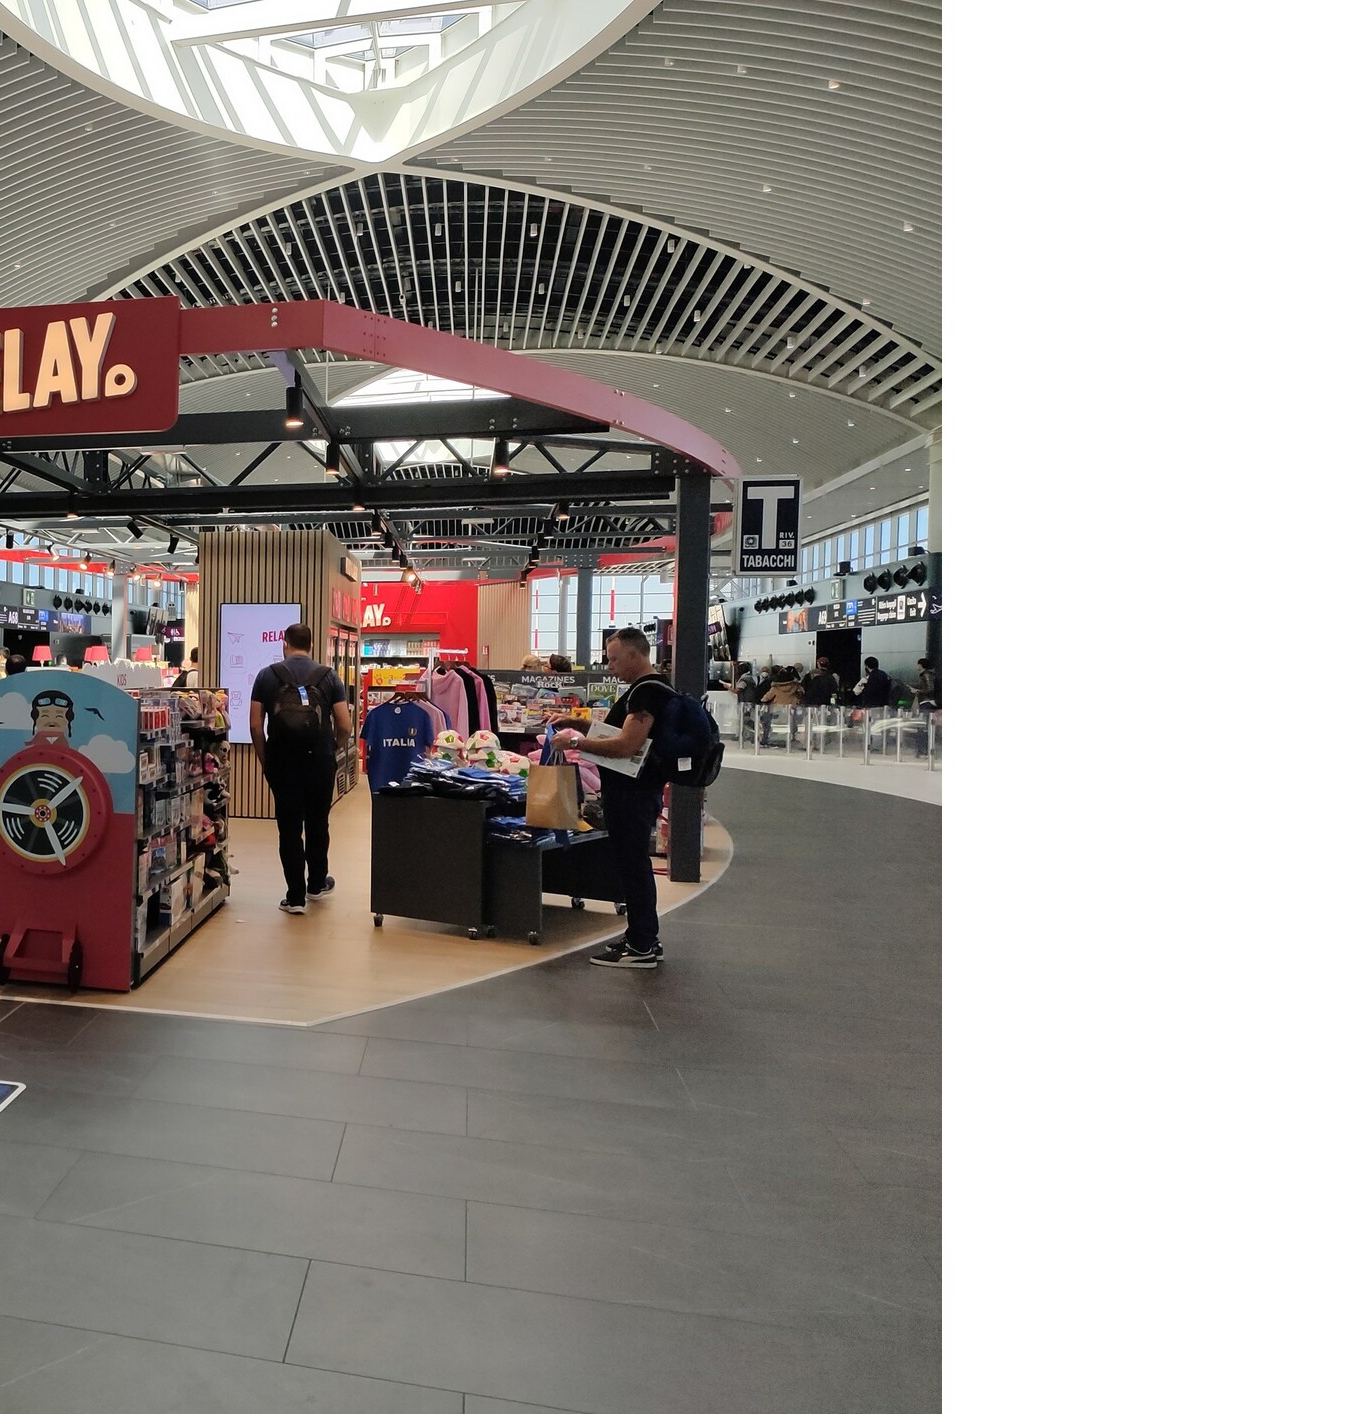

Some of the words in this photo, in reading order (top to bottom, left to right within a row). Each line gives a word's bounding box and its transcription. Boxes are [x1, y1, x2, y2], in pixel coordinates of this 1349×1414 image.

[747, 486, 795, 549] T
[781, 540, 793, 548] 36
[742, 554, 795, 568] TABACCHI
[261, 630, 287, 643] RELA
[117, 673, 127, 687] KIDS
[382, 738, 416, 748] ITALIA
